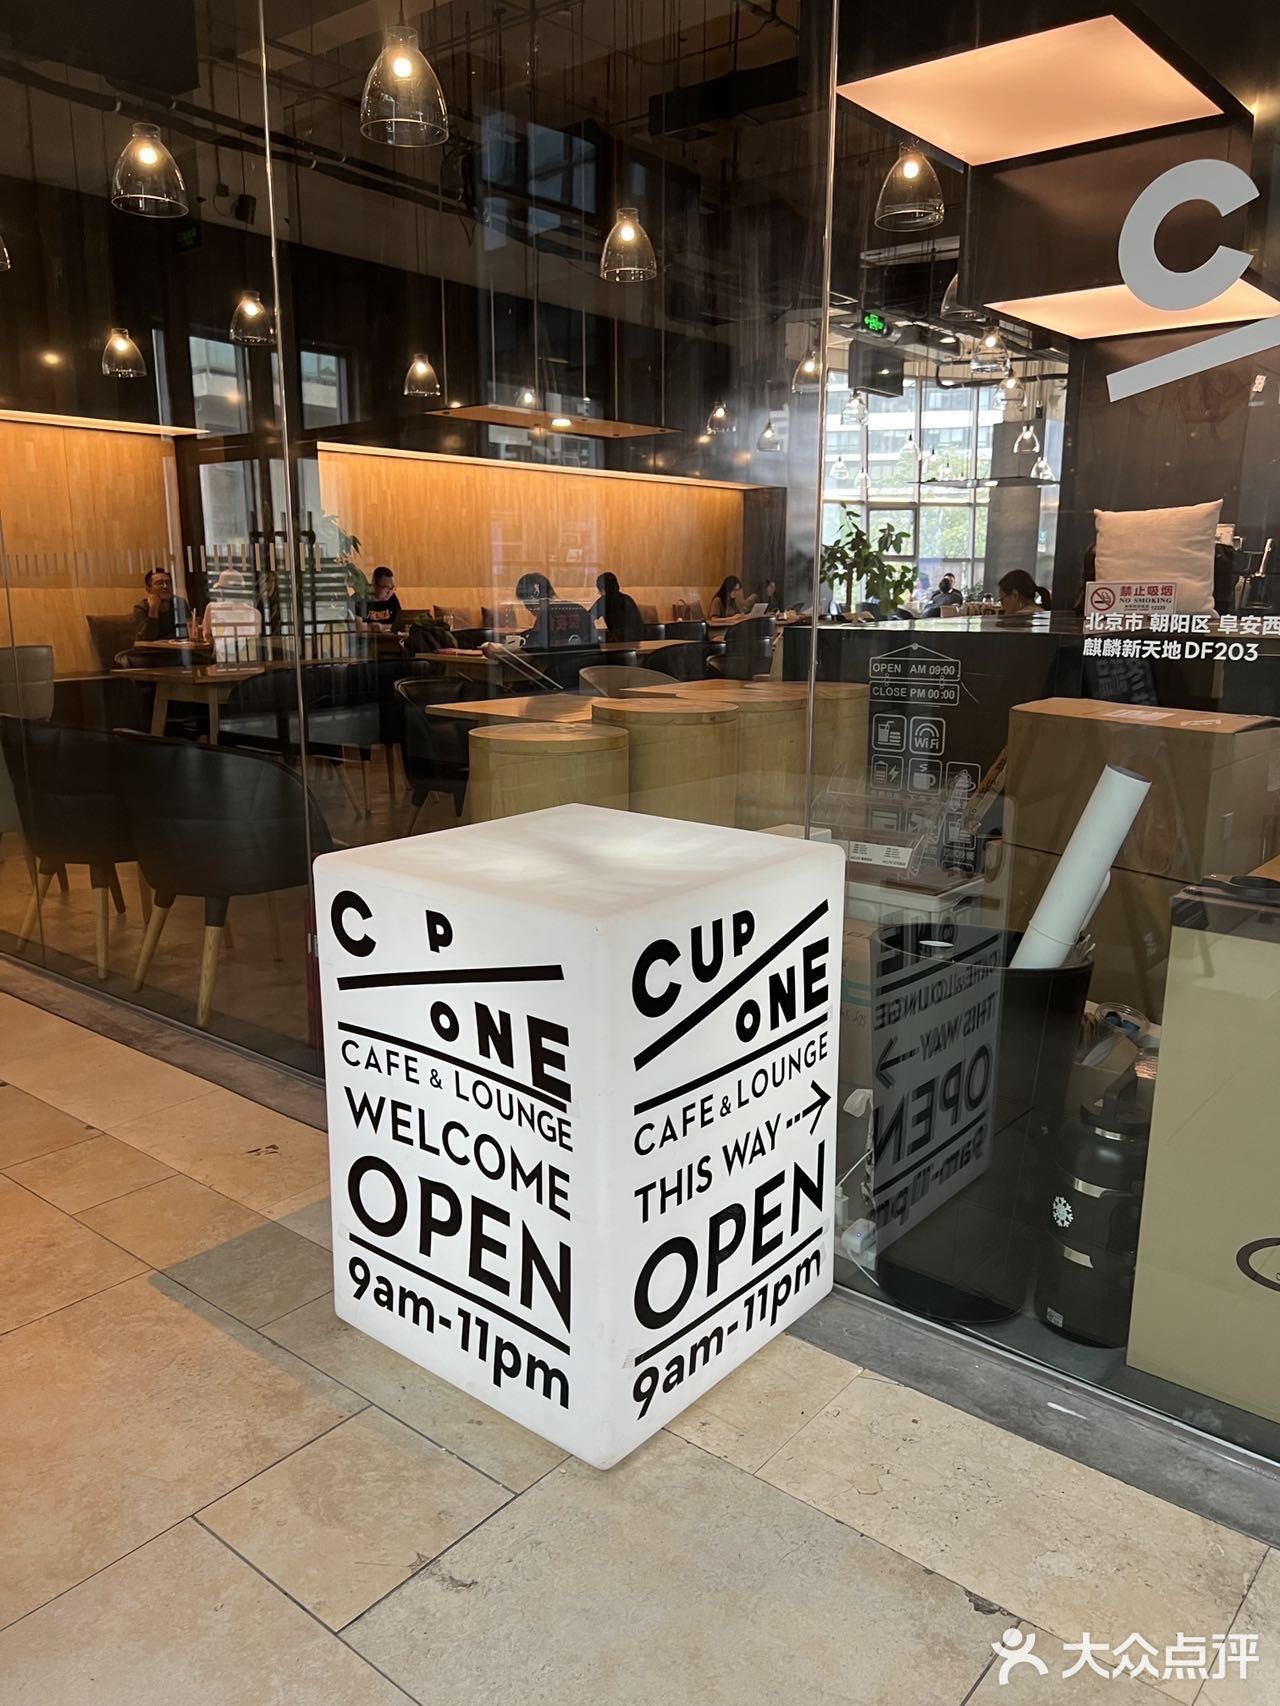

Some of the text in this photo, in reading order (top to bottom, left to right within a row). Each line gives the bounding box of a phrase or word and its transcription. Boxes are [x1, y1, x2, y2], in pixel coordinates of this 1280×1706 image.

[1118, 159, 1260, 311] C
[1085, 613, 1280, 636] 北京市 朝阳区 阜安西
[1120, 585, 1173, 597] 禁止吸烟
[872, 663, 955, 675] OPEN AM 09:00
[872, 687, 907, 697] CLOSE
[910, 688, 926, 698] PM
[1082, 638, 1259, 662] 麒麟新天地DF203
[632, 910, 755, 1017] CUP
[736, 937, 829, 1042] ONE
[341, 1040, 574, 1152] CAFE & LOUNGE
[430, 1001, 571, 1103] ONE
[635, 1031, 828, 1156] CAFE & LOUNGE
[344, 1086, 571, 1221] WELCOME
[635, 1113, 782, 1223] THIS WAY
[347, 1156, 571, 1333] OPEN
[634, 1140, 826, 1330] OPEN
[349, 1257, 570, 1410] 9am-11pm
[633, 1250, 821, 1421] 9am-11pm
